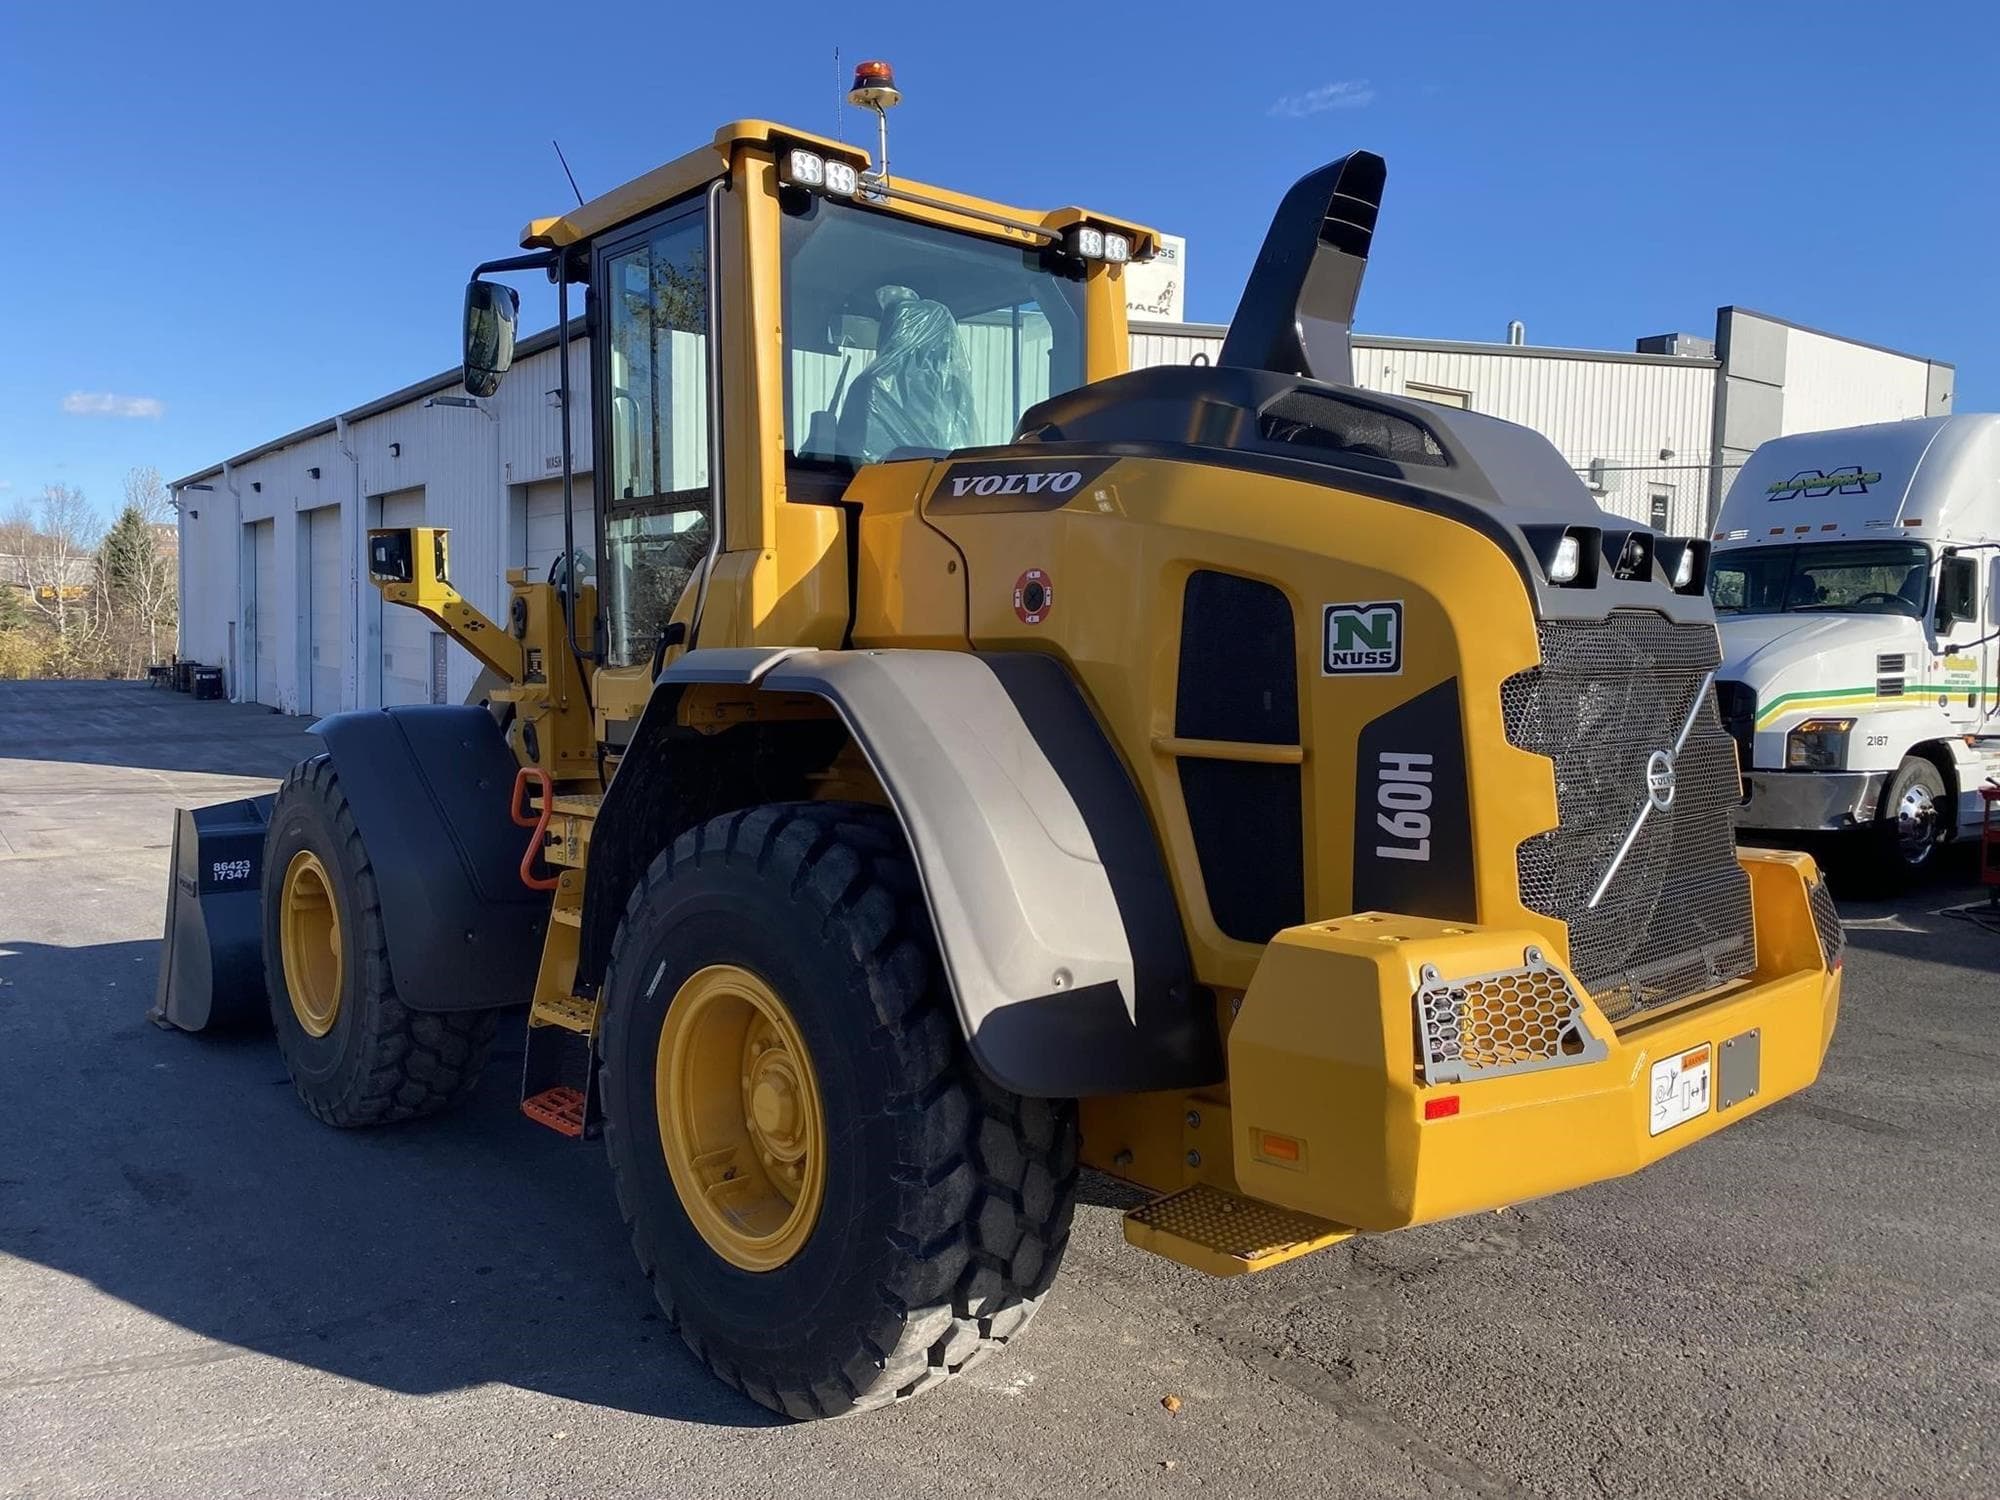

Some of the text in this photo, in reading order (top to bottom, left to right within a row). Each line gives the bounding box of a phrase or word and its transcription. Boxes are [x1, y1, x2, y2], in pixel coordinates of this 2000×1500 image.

[952, 471, 1082, 497] VOLVO
[1333, 613, 1393, 650] N
[1332, 651, 1392, 665] NUSS
[1867, 735, 1888, 746] 2187
[1376, 752, 1433, 861] L60H
[213, 860, 251, 871] 86423
[213, 869, 251, 881] 17347
